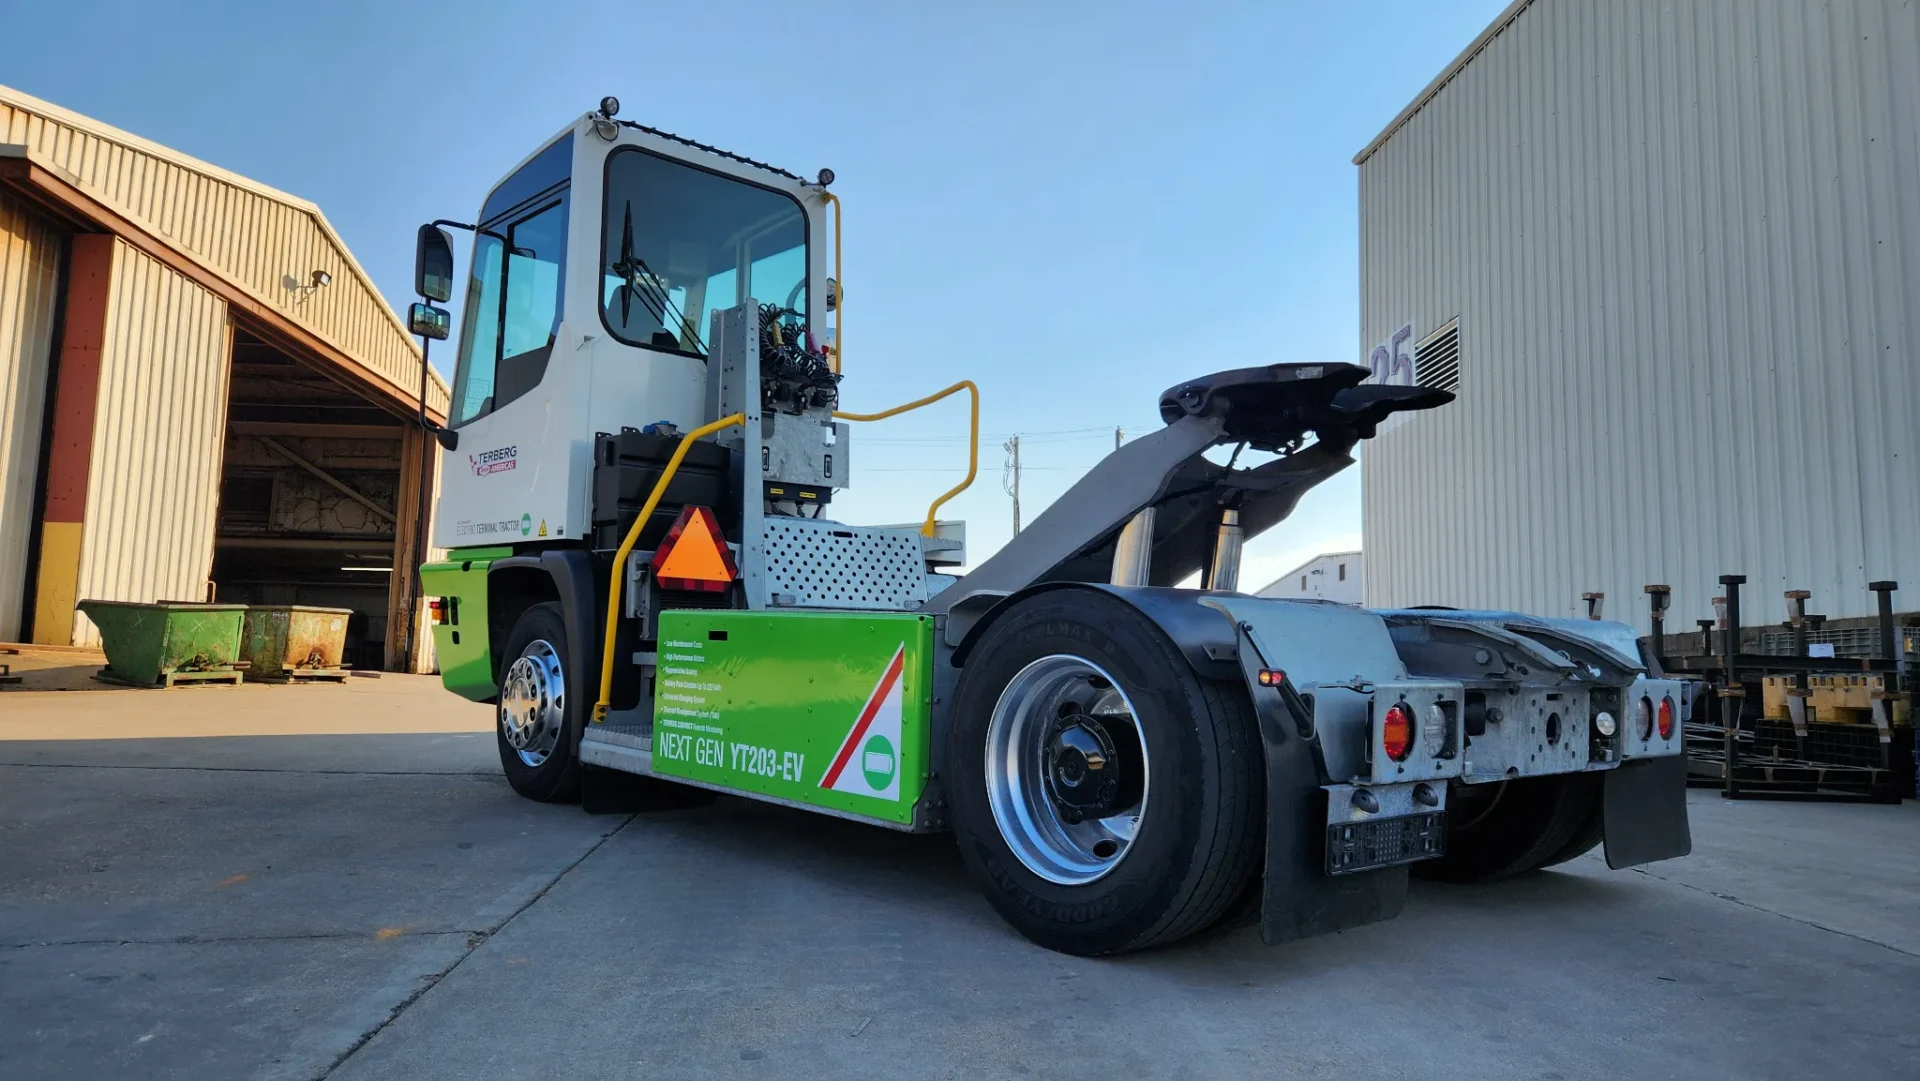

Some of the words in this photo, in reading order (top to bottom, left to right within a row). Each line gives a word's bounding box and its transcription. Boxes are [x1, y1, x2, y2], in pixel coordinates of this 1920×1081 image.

[479, 445, 517, 464] TERBERG
[490, 460, 515, 472] AMERICAS
[476, 523, 498, 534] TERMINAL
[499, 520, 520, 531] TRACTOR
[659, 732, 692, 762] NEXT
[695, 737, 724, 767] GEN
[730, 742, 804, 782] YT203-EV
